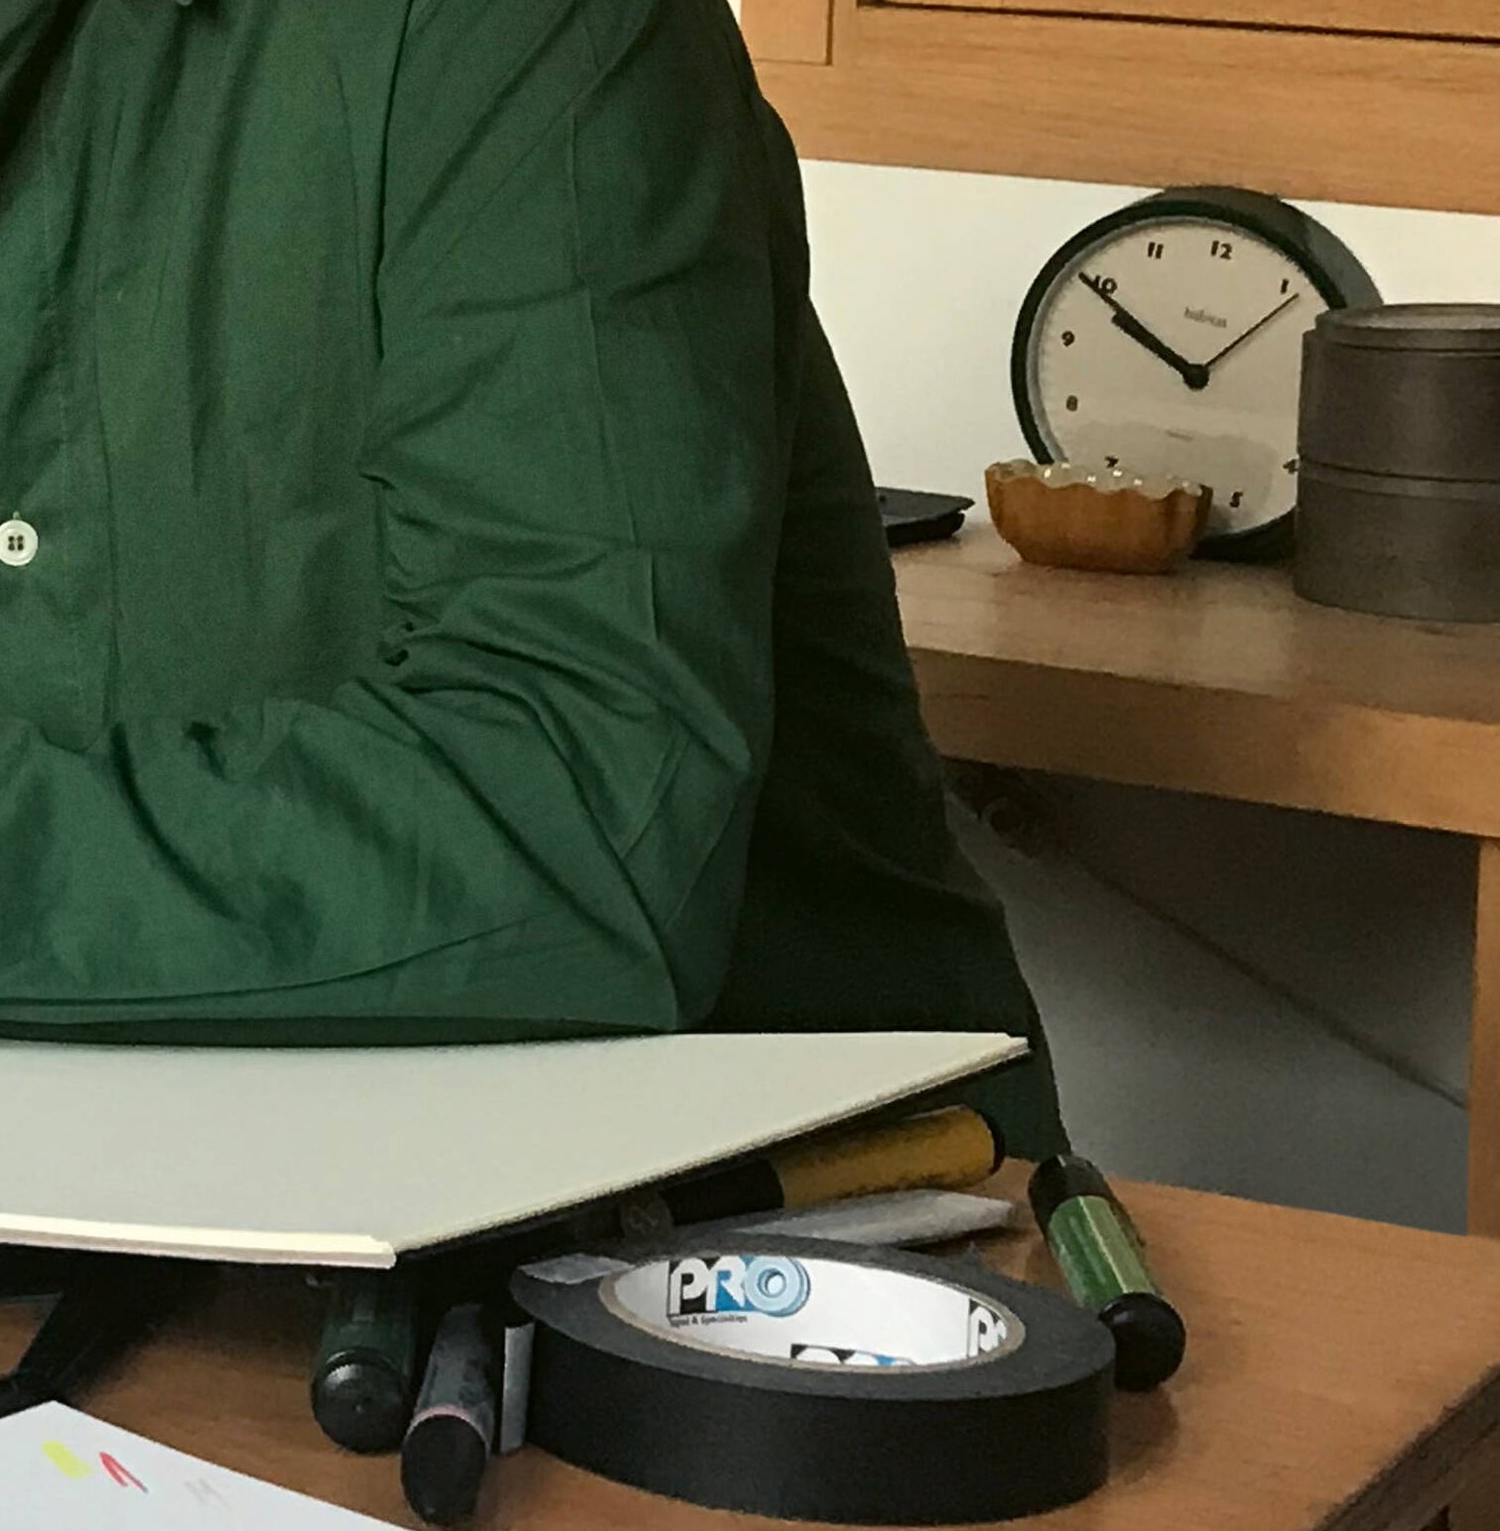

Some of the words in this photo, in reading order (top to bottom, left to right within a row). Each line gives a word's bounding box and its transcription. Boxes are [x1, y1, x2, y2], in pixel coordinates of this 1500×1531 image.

[1147, 242, 1164, 260] 11
[1210, 240, 1233, 261] 12
[1280, 278, 1290, 295] 1
[1061, 330, 1076, 348] 9
[1065, 394, 1079, 412] 8
[1229, 490, 1244, 509] 5
[668, 1255, 811, 1318] PRO
